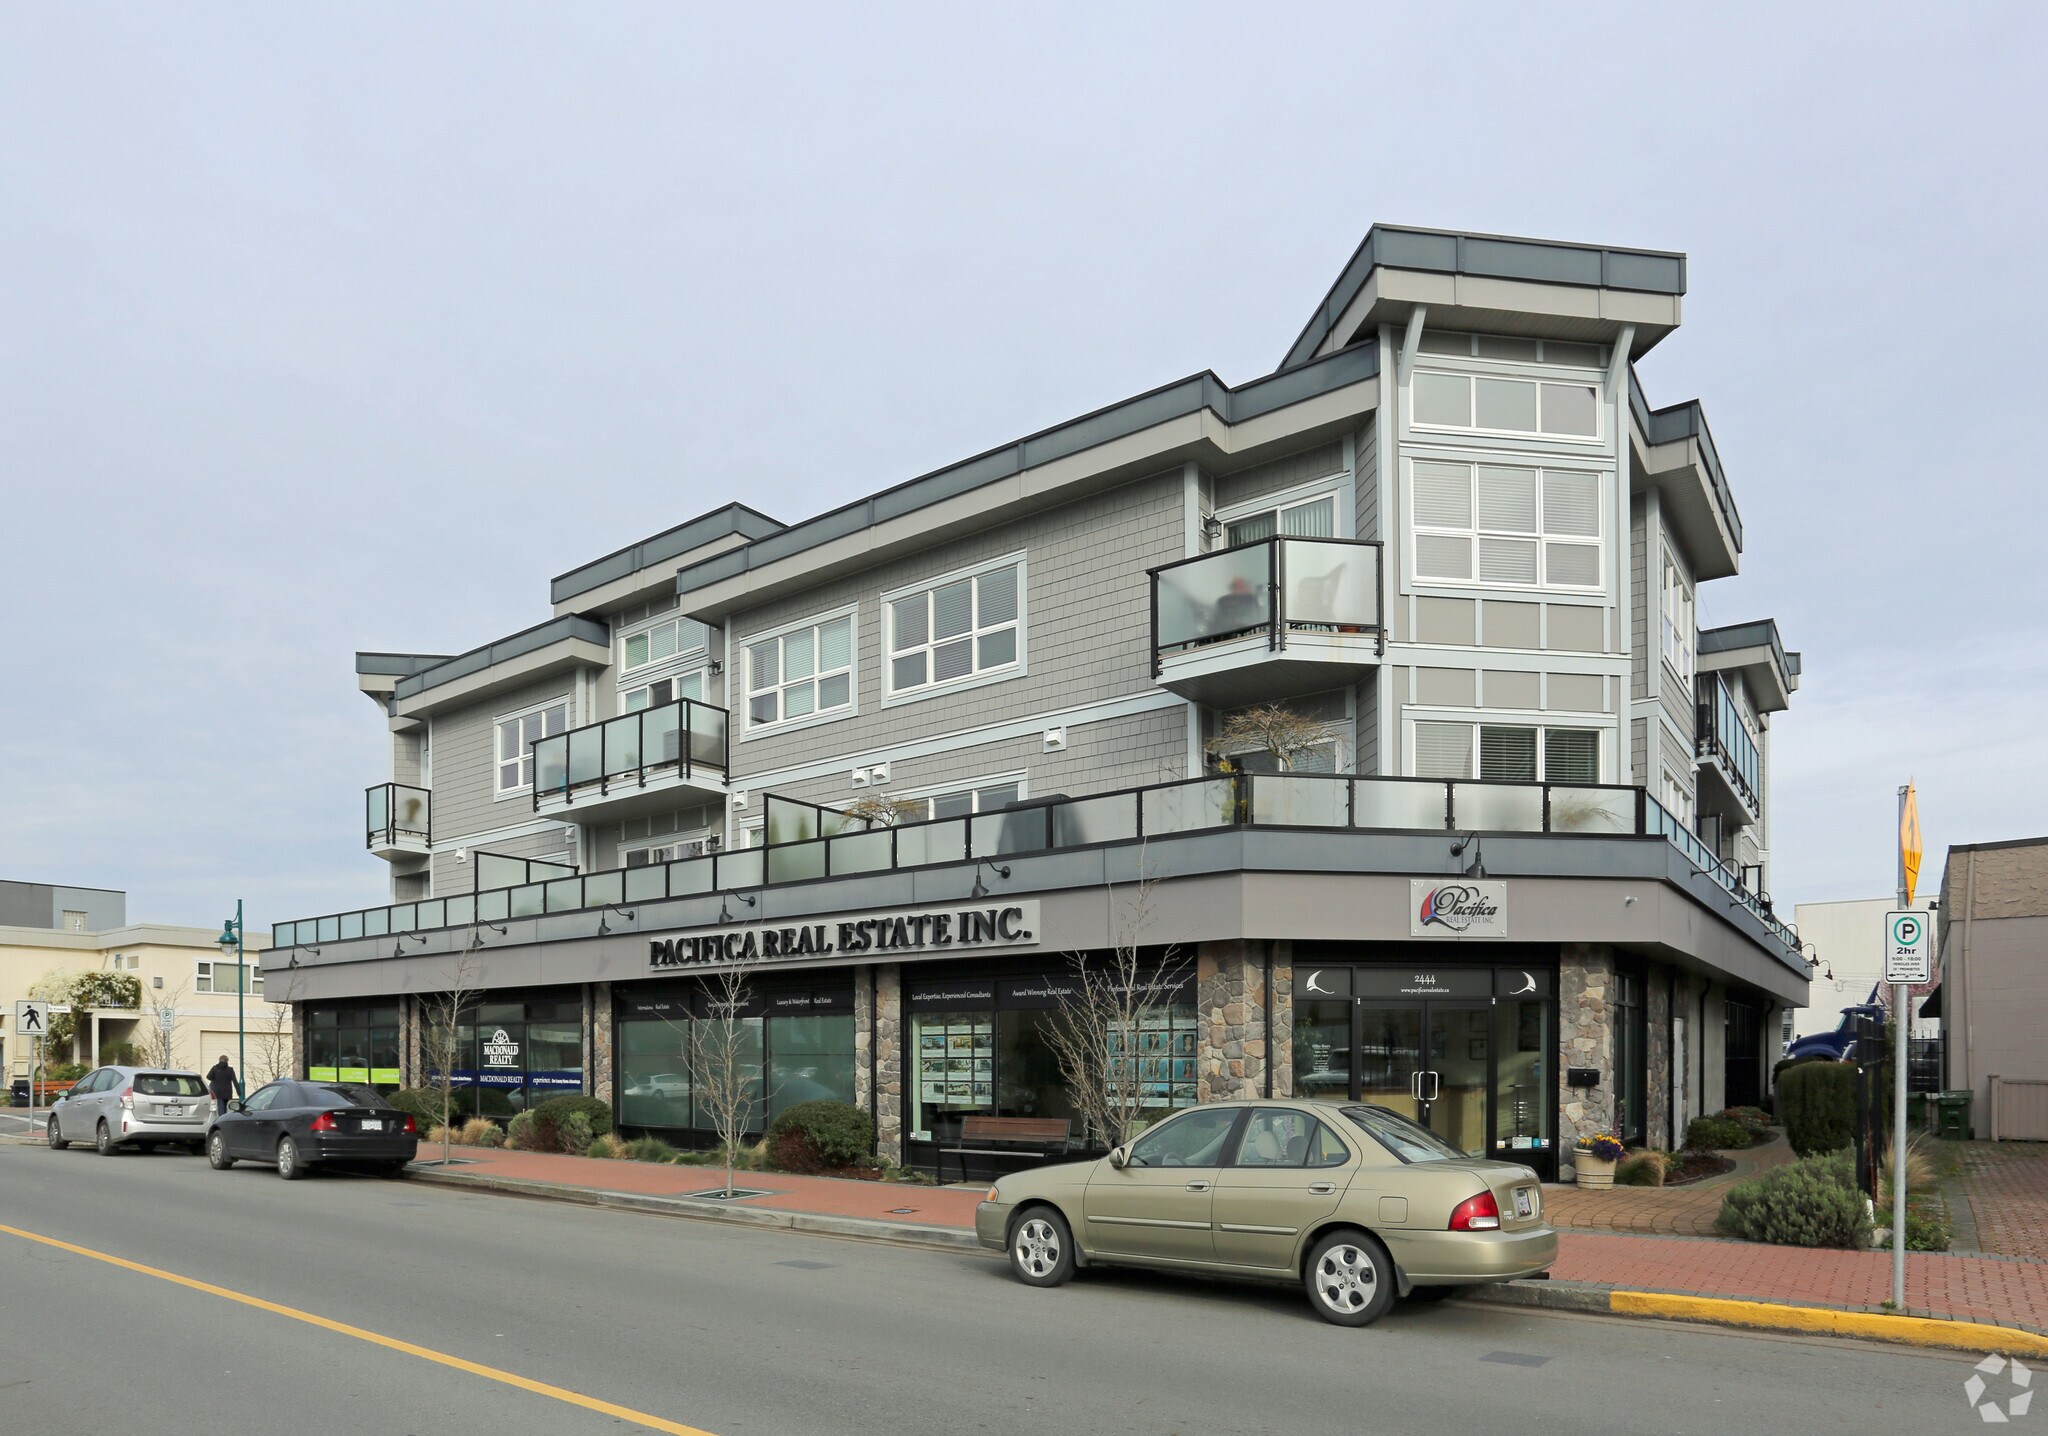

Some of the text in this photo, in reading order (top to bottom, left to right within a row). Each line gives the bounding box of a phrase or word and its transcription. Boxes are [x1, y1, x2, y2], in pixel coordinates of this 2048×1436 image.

[1434, 885, 1498, 917] Pacifica
[1446, 916, 1460, 924] REAL
[1461, 916, 1481, 924] ESTATE
[649, 906, 1033, 966] PACIFICA REAL ESTATE INC.
[1902, 923, 1915, 940] P
[1896, 946, 1917, 955] 2hr
[1414, 974, 1436, 985] 2444
[942, 991, 966, 1001] Experienced
[966, 990, 992, 999] Consultants
[1012, 989, 1027, 997] Award
[1027, 988, 1047, 997] Winning
[1057, 987, 1072, 995] Estate
[483, 1045, 519, 1055] MACDONALD
[489, 1055, 513, 1065] REALTY
[480, 1075, 507, 1083] MACDONALD
[507, 1076, 524, 1084] REALTY
